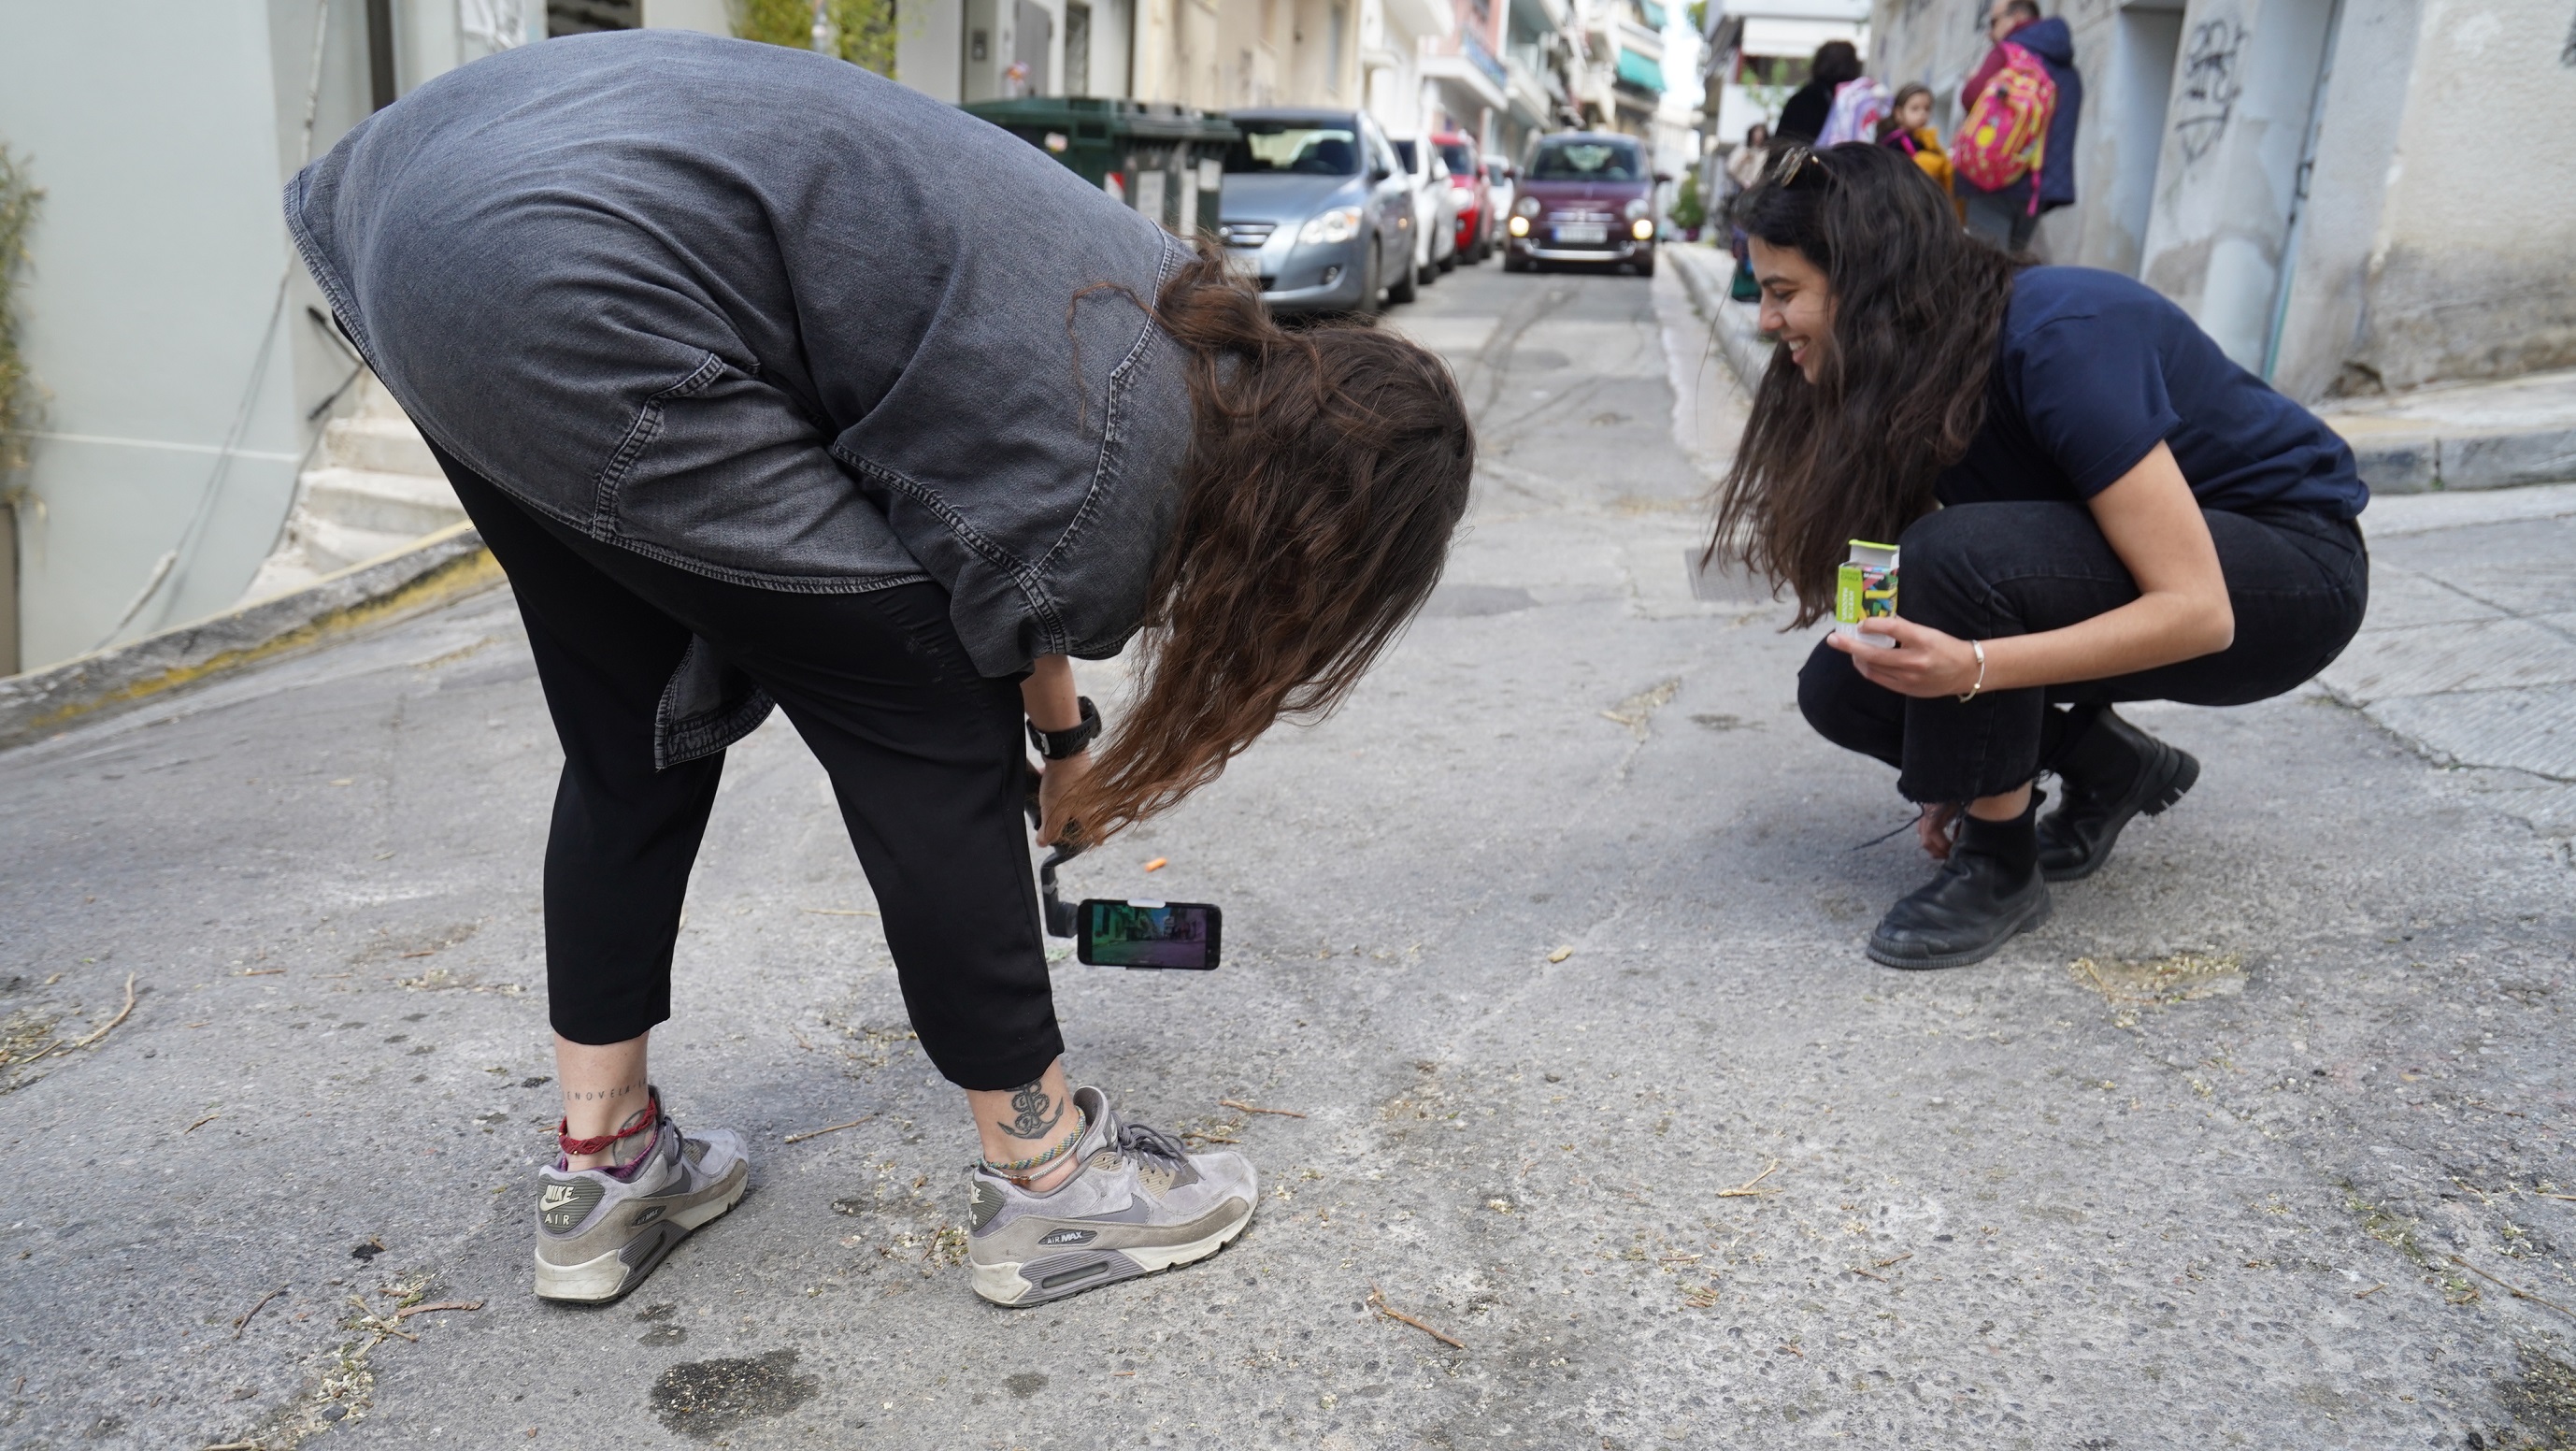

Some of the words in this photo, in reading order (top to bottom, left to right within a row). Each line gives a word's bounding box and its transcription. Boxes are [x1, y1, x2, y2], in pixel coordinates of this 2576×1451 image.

[545, 1184, 575, 1201] NIKE
[544, 1213, 570, 1226] AIR
[1047, 1236, 1060, 1244] AIR
[1061, 1231, 1082, 1243] MAX
